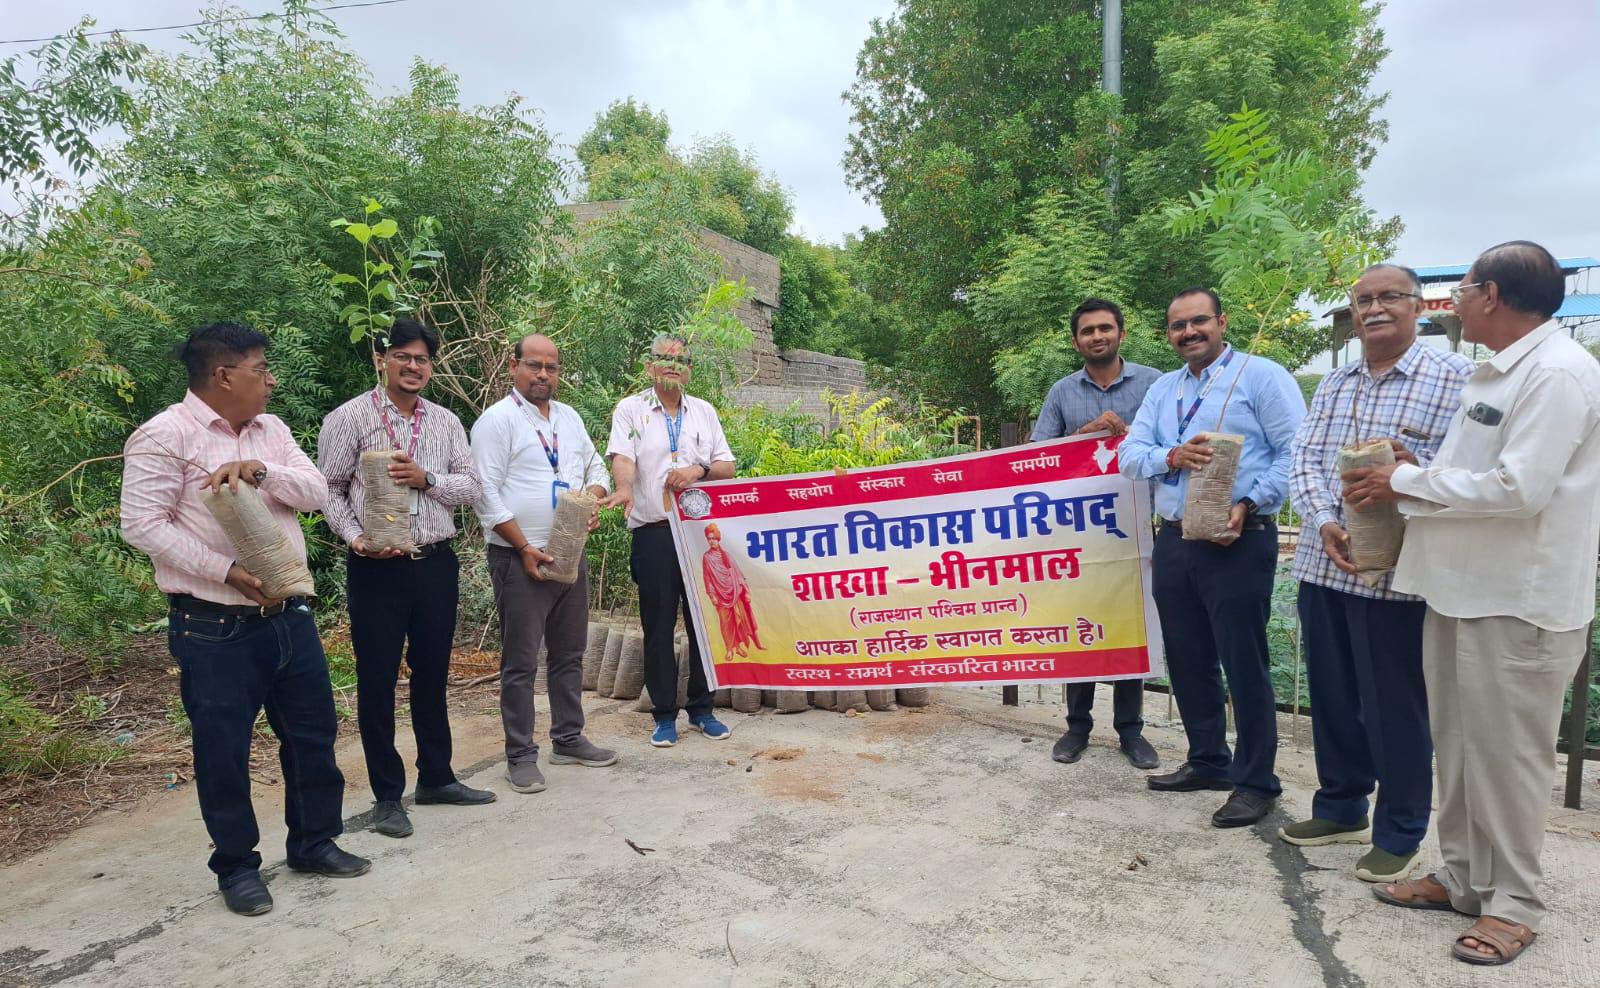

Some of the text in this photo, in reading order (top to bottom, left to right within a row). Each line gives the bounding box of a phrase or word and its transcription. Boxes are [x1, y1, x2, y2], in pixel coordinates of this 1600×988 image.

[718, 488, 760, 507] सम्पर्क
[786, 482, 834, 501] सहयोग
[857, 476, 905, 493] संस्कार
[932, 469, 963, 485] सेवा
[1009, 452, 1061, 474] समर्पण
[746, 491, 1128, 563] भारत विकास परिषद्
[791, 567, 889, 602] शाखा
[929, 548, 1082, 590] भीनमाल
[928, 600, 977, 618] पश्चिम
[796, 638, 858, 657] आपका
[864, 630, 928, 657] हार्दिक
[935, 628, 1003, 648] स्वागत
[1010, 625, 1069, 645] करता
[786, 667, 831, 680] स्वस्थ
[847, 662, 893, 679] समर्थ
[909, 657, 998, 677] संस्कारित
[1003, 658, 1056, 672] भारत
